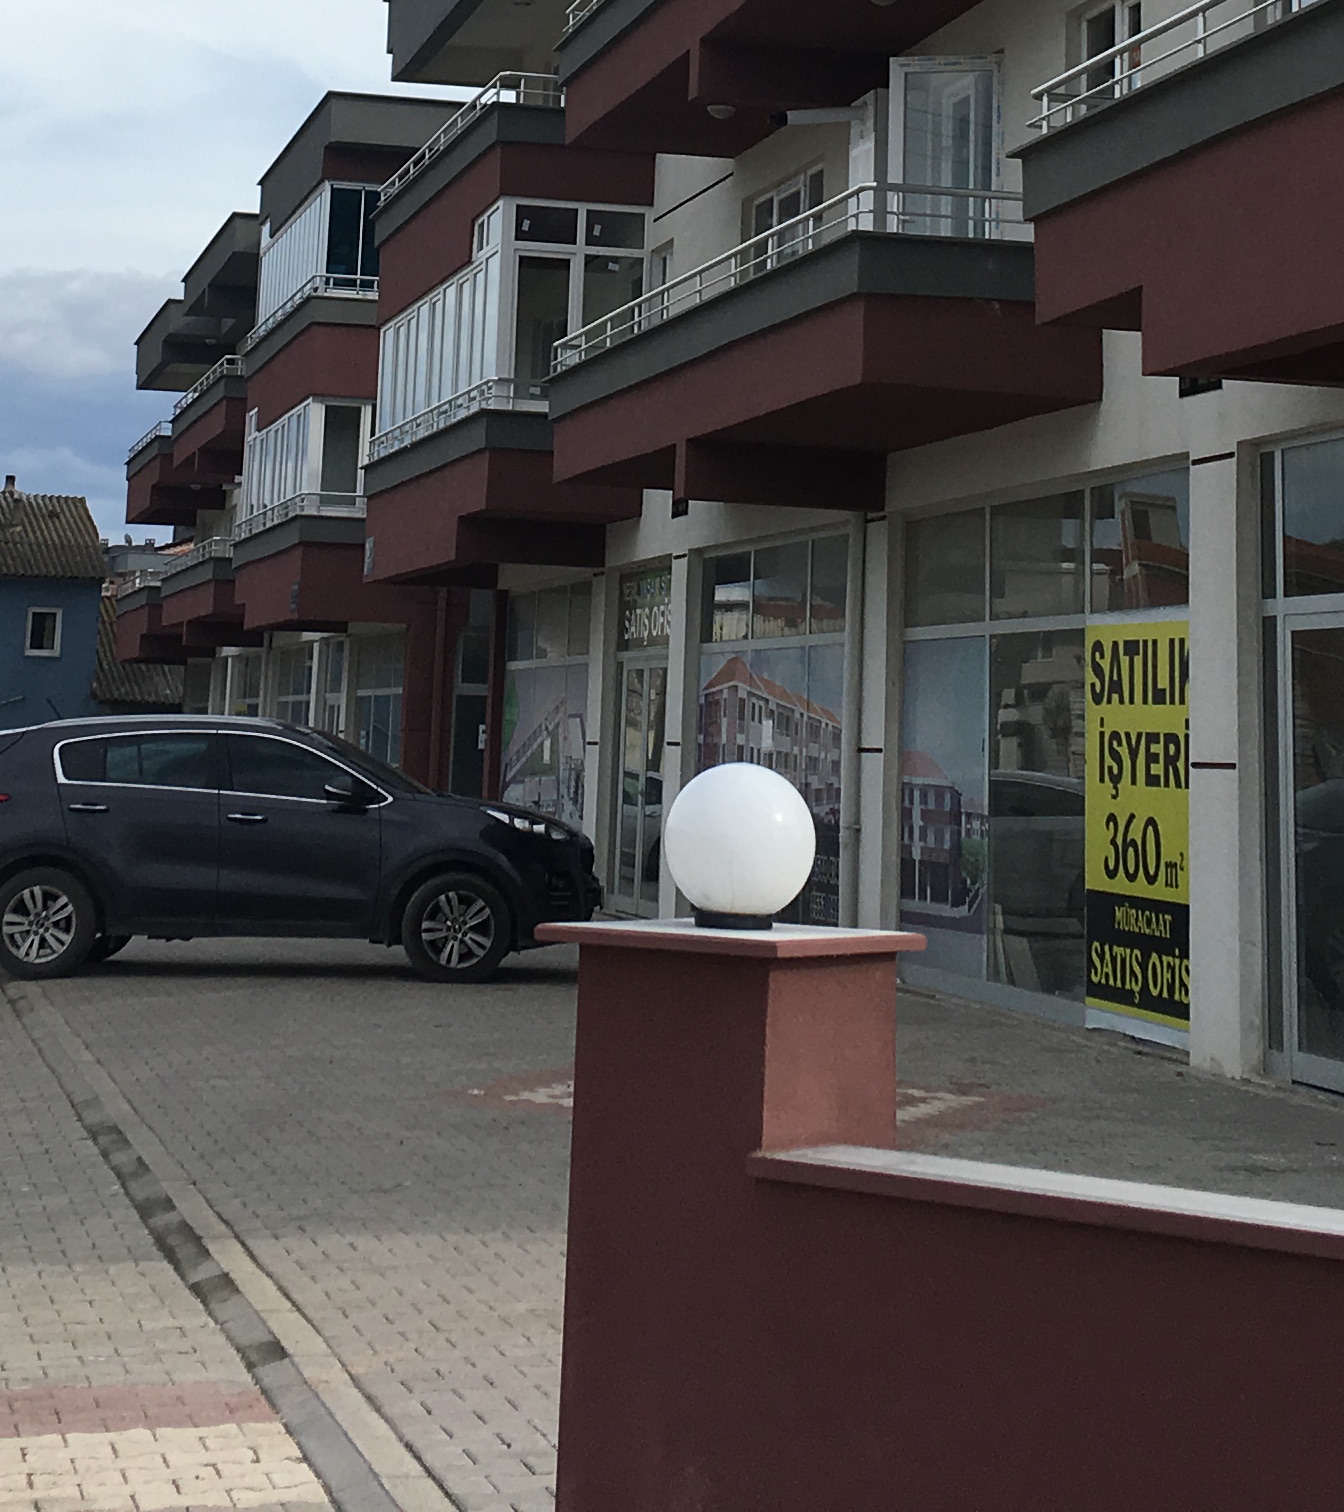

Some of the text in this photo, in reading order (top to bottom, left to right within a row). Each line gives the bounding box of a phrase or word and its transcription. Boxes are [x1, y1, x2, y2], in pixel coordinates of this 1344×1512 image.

[624, 607, 650, 645] SATIŞ
[1099, 717, 1190, 800] İŞYERİ
[1103, 812, 1162, 886] 360
[1115, 902, 1172, 939] MÜRACAAT
[1090, 941, 1143, 1004] SATIŞ
